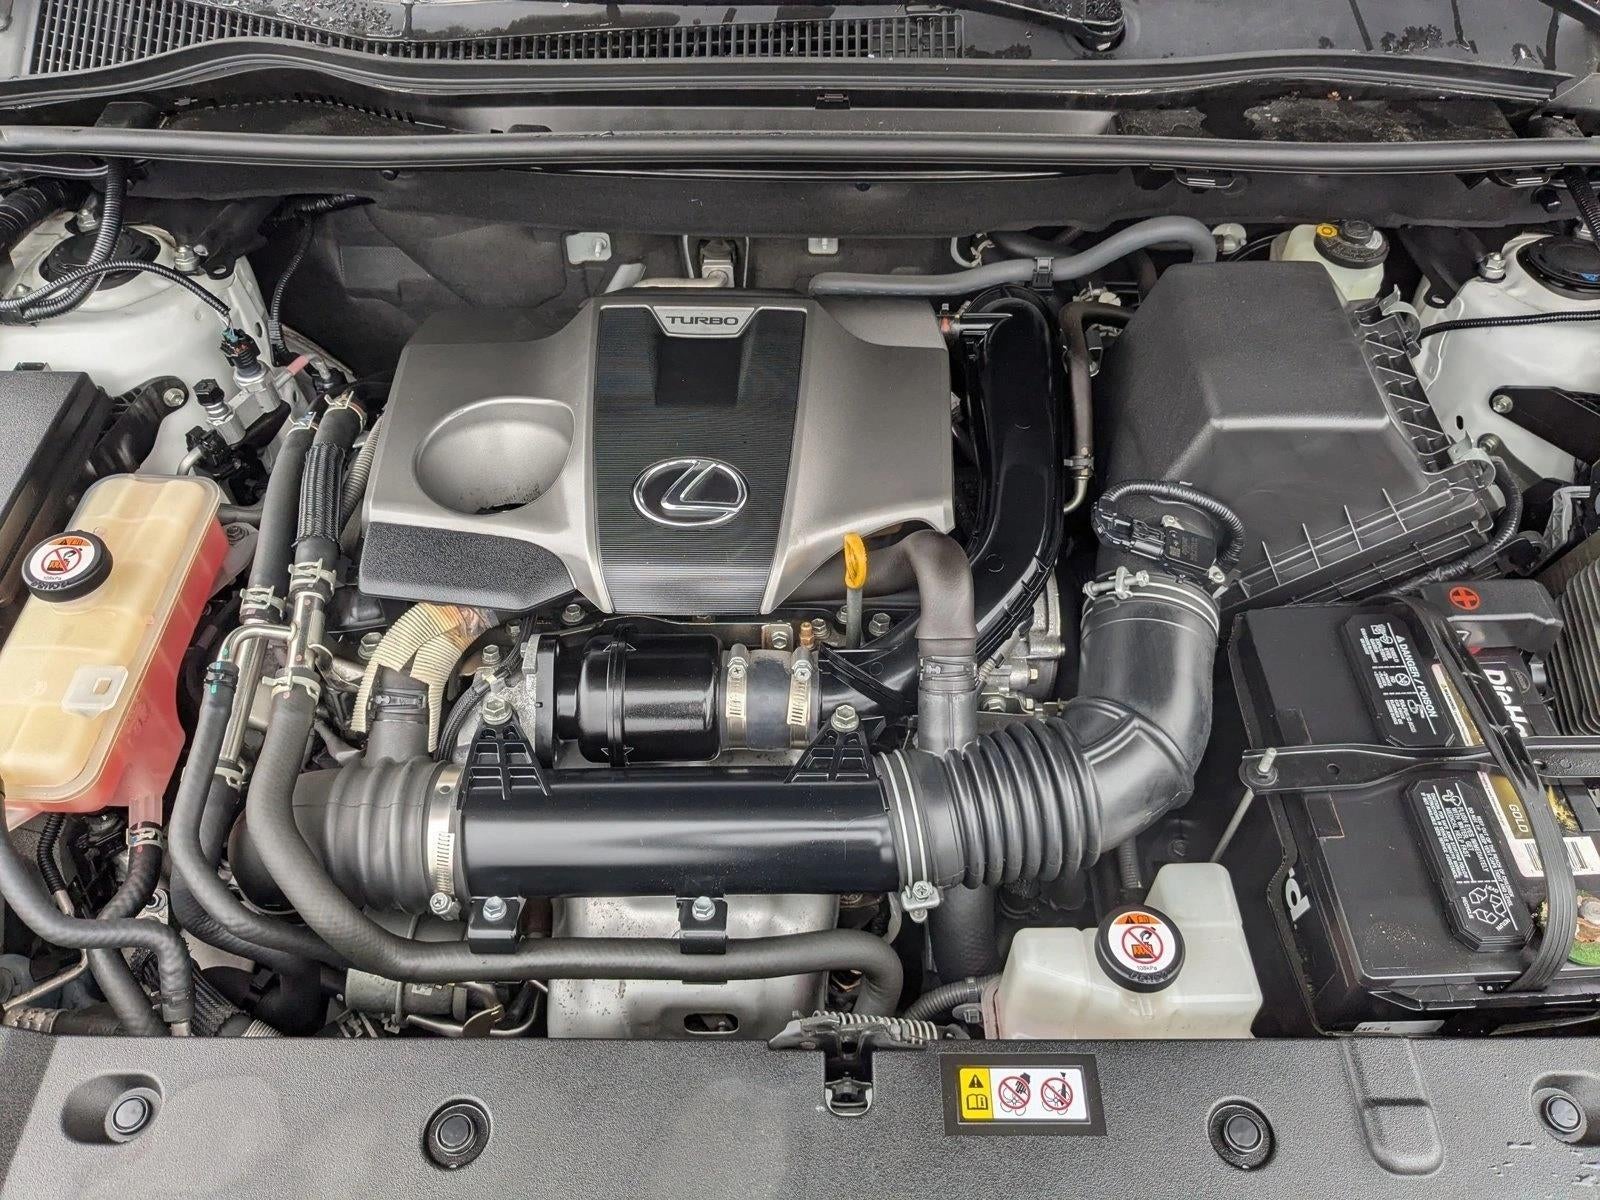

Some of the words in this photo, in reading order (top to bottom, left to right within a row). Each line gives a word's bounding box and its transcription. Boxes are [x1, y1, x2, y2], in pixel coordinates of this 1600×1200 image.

[665, 315, 739, 326] TURBO
[1398, 643, 1420, 677] DANGER
[1416, 685, 1437, 716] POISON
[1483, 669, 1529, 737] DieHa
[1444, 807, 1458, 828] MEDICAL
[1453, 829, 1464, 843] HELP
[1460, 845, 1470, 857] FAST
[1463, 824, 1474, 836] EYES
[1508, 803, 1529, 833] GOLD
[1461, 896, 1475, 919] RECYCLE
